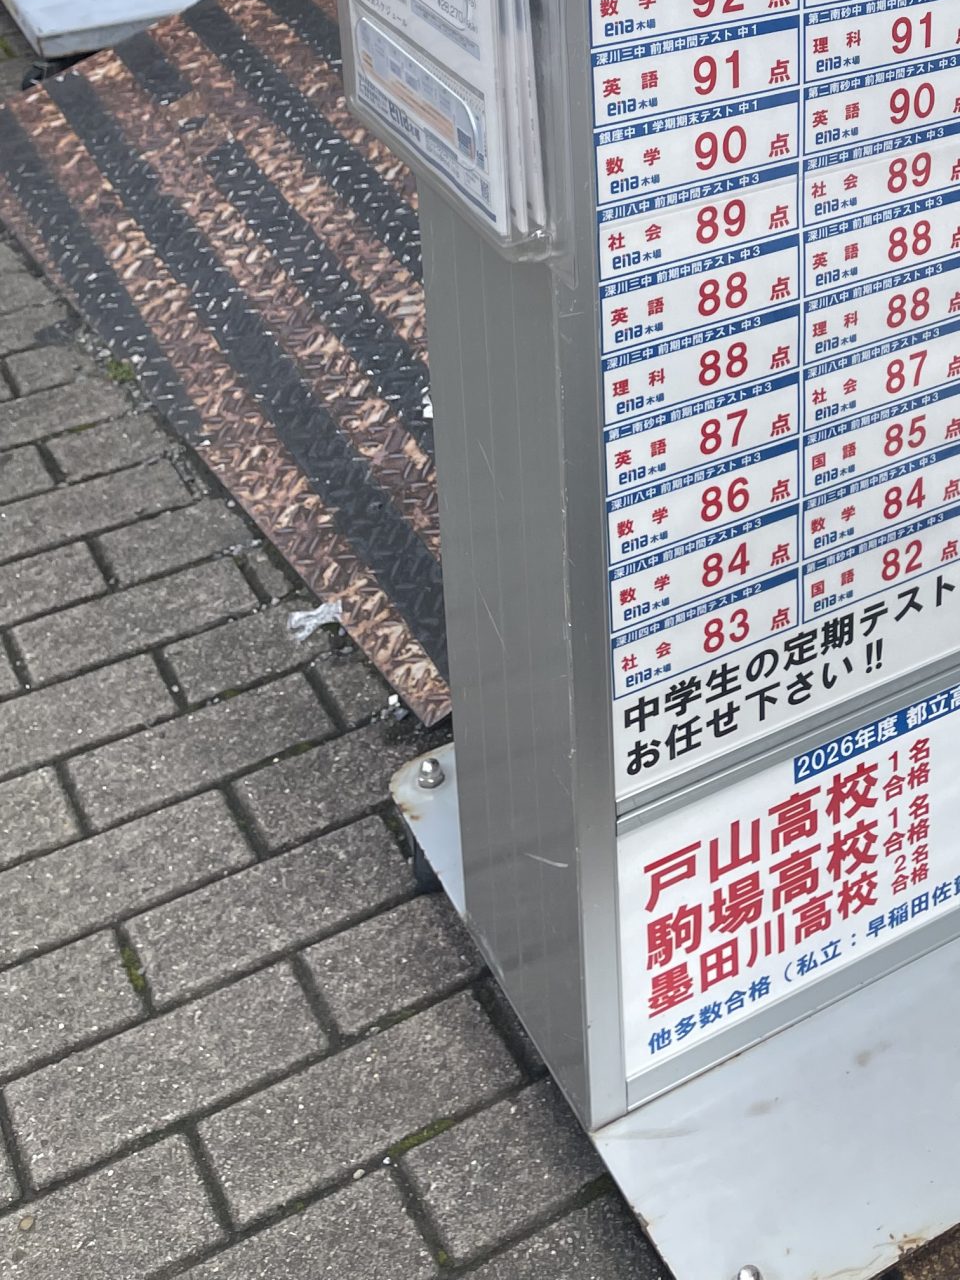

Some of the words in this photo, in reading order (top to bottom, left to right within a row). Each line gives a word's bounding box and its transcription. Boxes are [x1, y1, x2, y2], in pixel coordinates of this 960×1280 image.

[599, 127, 639, 146] 銀座中
[643, 104, 734, 135] 1学期期末テスト
[739, 99, 759, 116] 中1
[627, 638, 884, 775] お任せ下さい!!
[796, 716, 898, 778] 2026年度
[883, 762, 931, 801] 合格
[643, 762, 878, 912] 戸山高校
[883, 818, 930, 857] 合格
[646, 819, 878, 970] 駒場高校
[891, 864, 929, 895] 合格
[649, 870, 878, 1018] 墨田川高校
[648, 975, 771, 1055] 他多数合格
